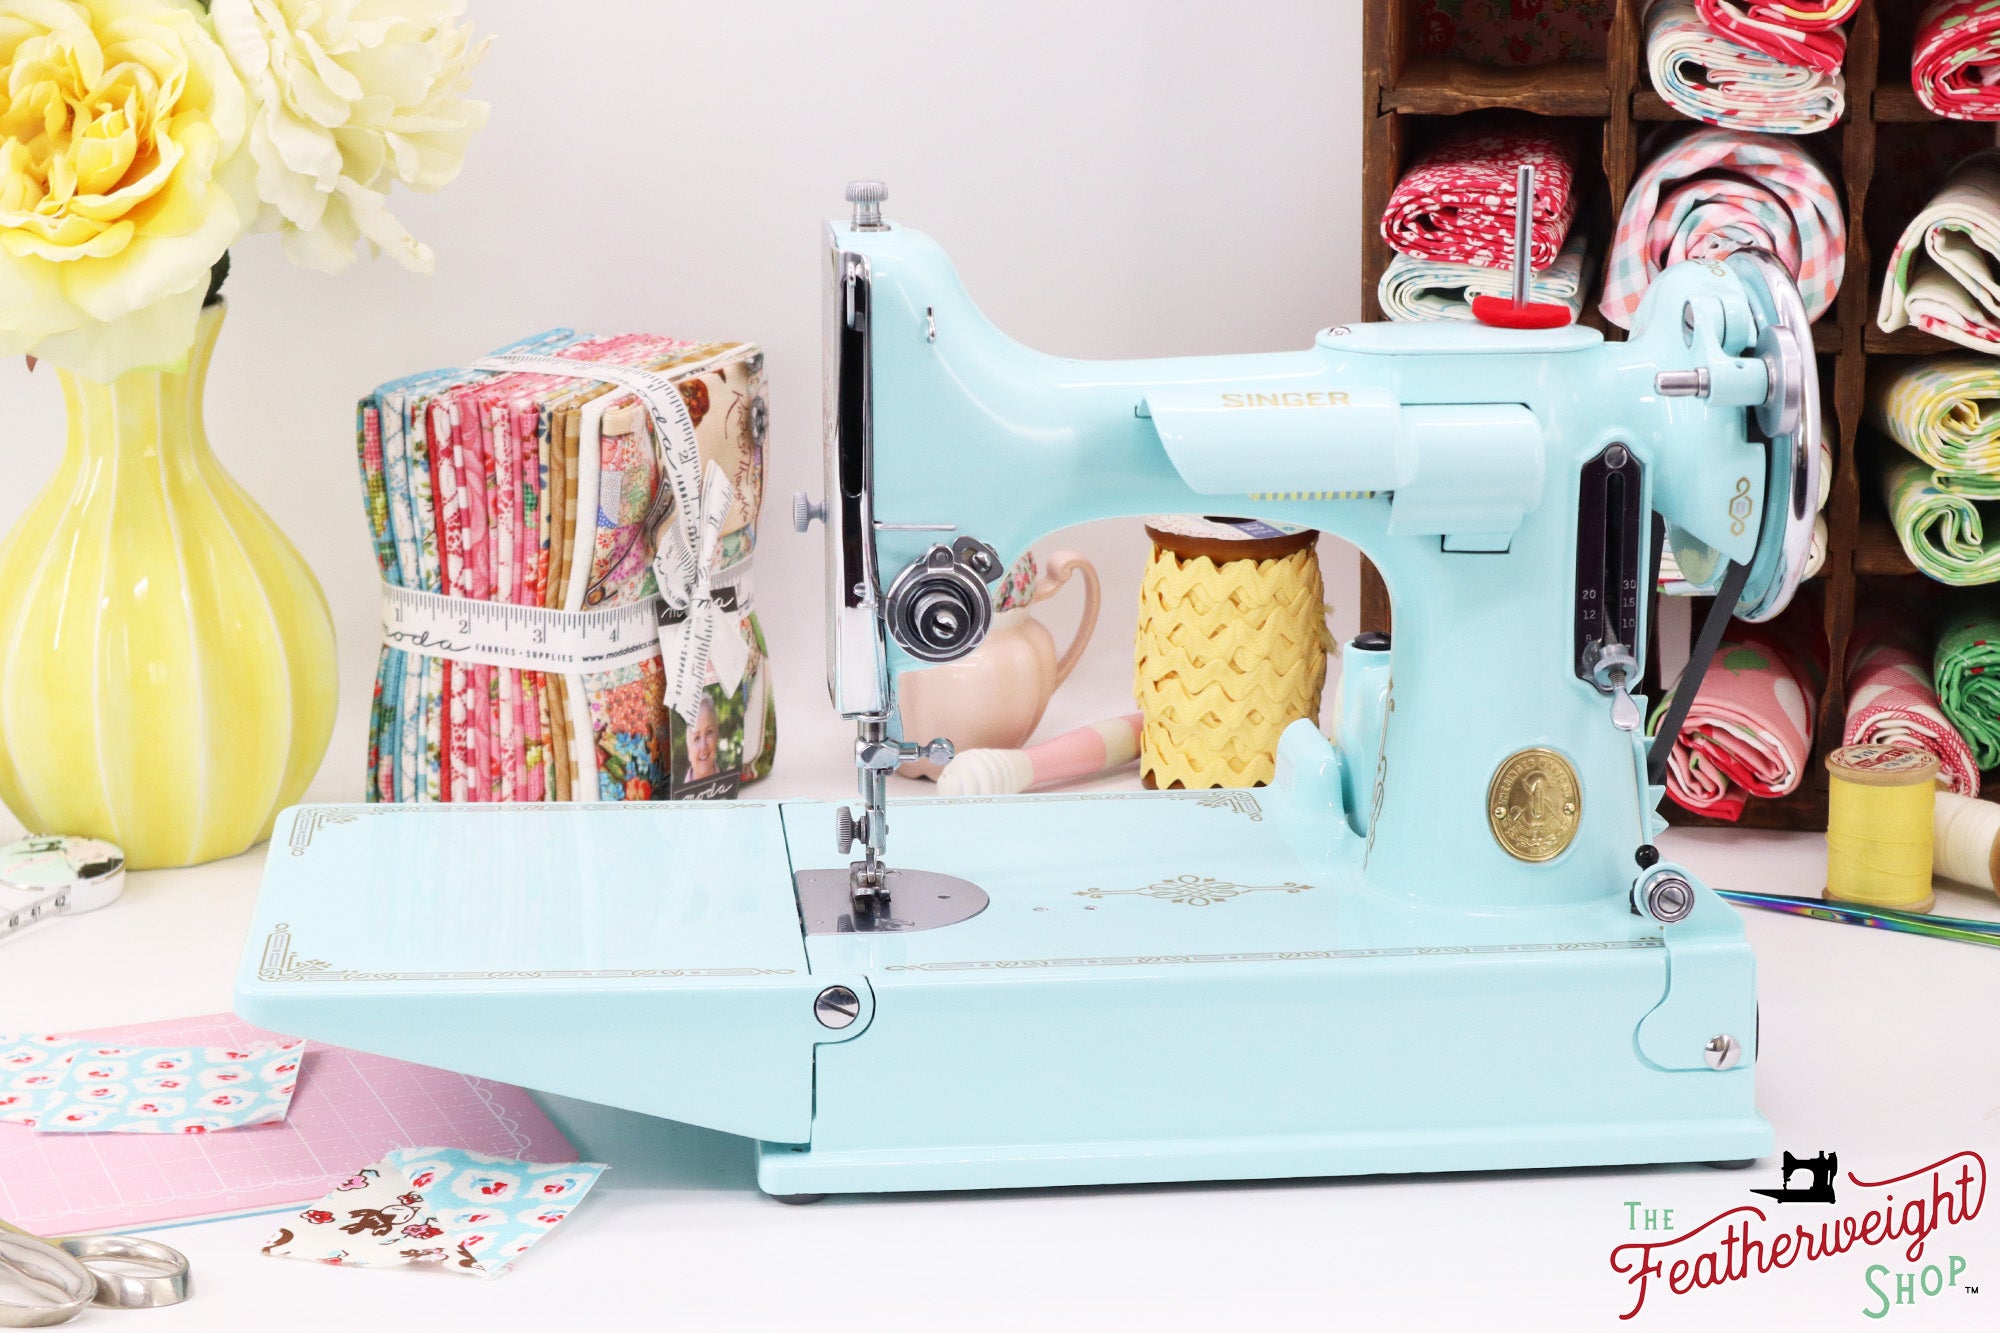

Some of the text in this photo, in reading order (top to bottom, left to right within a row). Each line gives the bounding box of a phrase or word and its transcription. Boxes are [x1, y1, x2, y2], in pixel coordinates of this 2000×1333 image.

[1222, 392, 1350, 408] SINGER
[1622, 580, 1637, 590] 30
[1582, 590, 1597, 600] 20
[1622, 598, 1635, 608] 15
[1583, 609, 1596, 620] 12
[459, 620, 468, 634] 2
[1622, 618, 1635, 629] 10
[532, 628, 543, 644] 3
[609, 628, 617, 643] 4
[475, 643, 516, 657] FABRICS
[526, 650, 574, 663] SUPPLIES
[683, 782, 733, 800] moda
